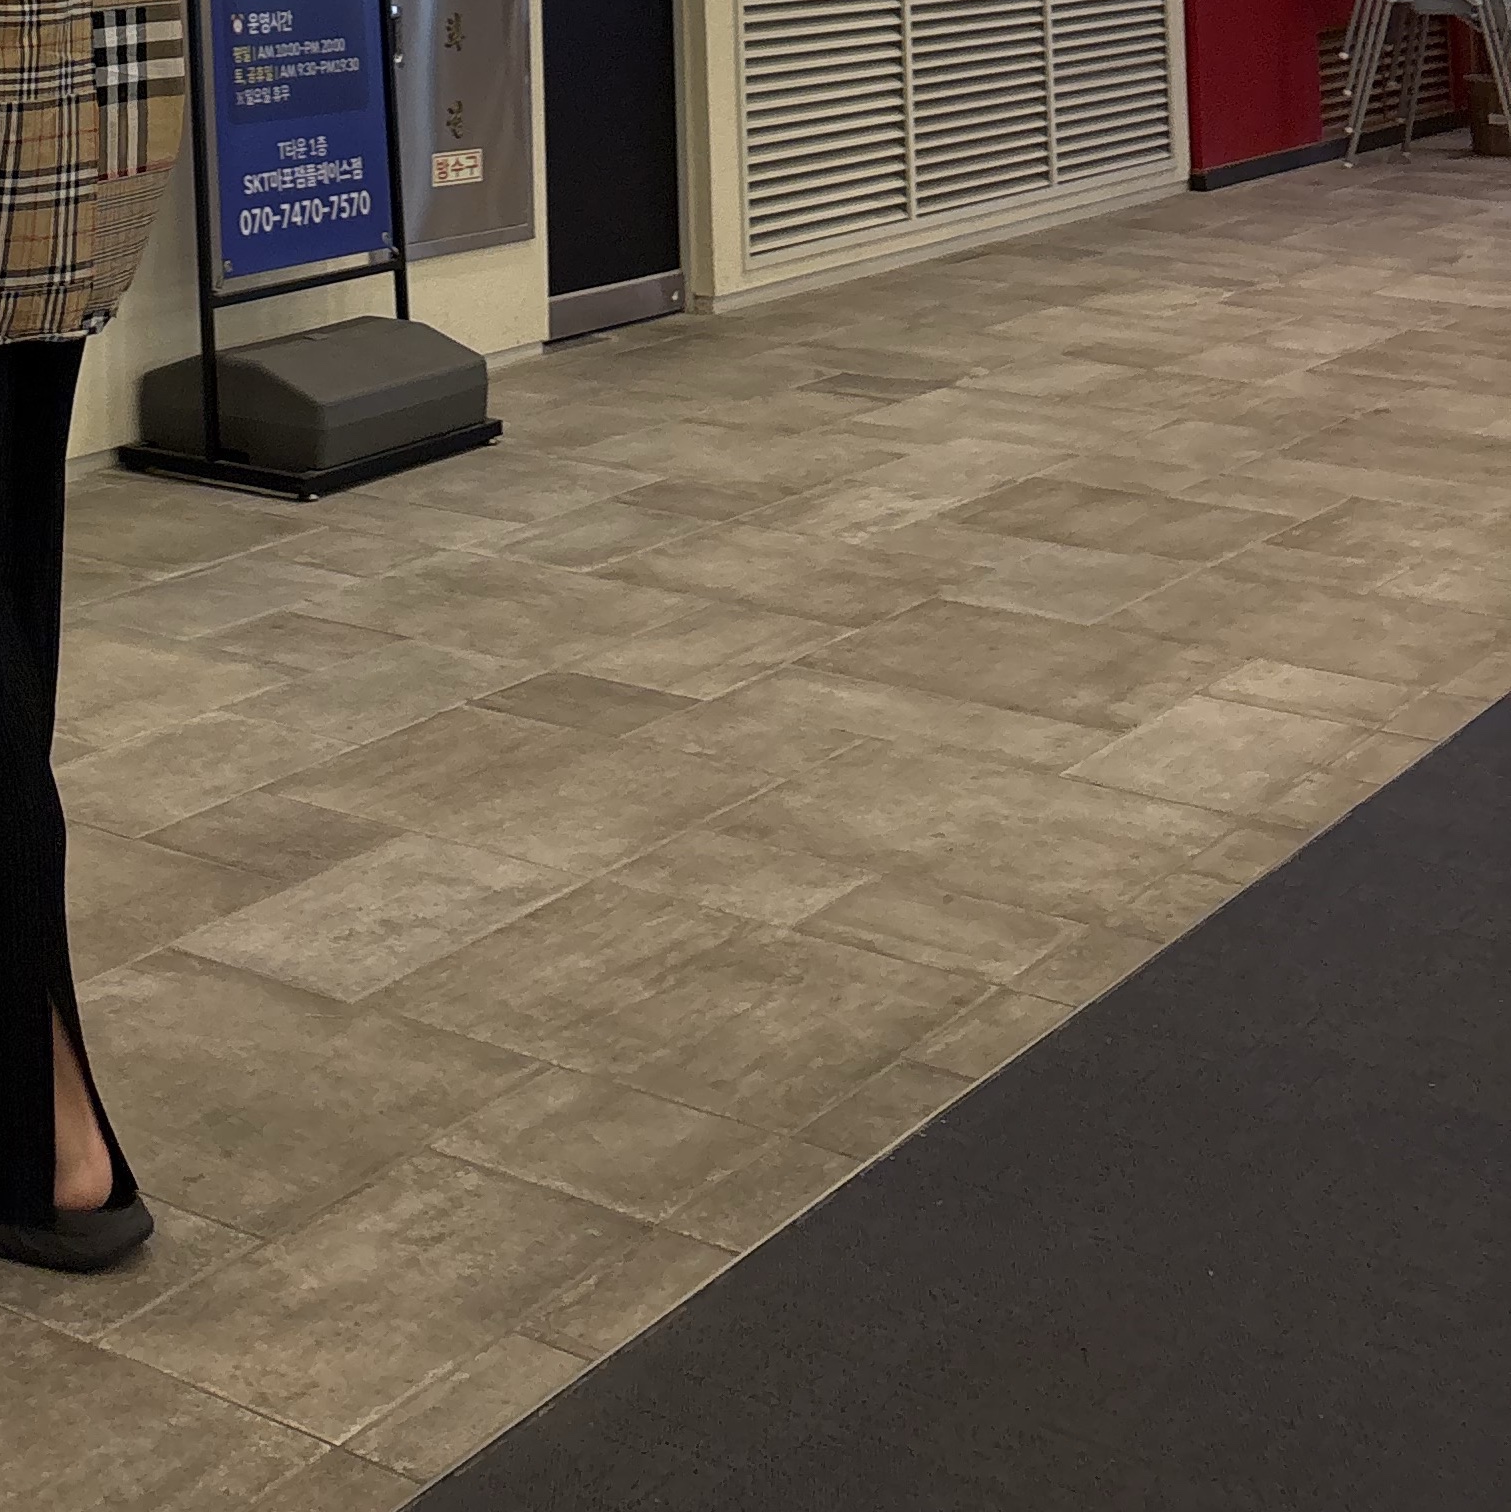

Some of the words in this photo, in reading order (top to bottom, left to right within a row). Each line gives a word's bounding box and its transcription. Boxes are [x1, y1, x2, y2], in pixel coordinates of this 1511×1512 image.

[247, 9, 293, 35] 운영시간
[277, 137, 308, 160] T타운
[308, 135, 329, 157] 1층
[436, 155, 479, 180] 방수구
[239, 190, 371, 236] 070-7470-7570
